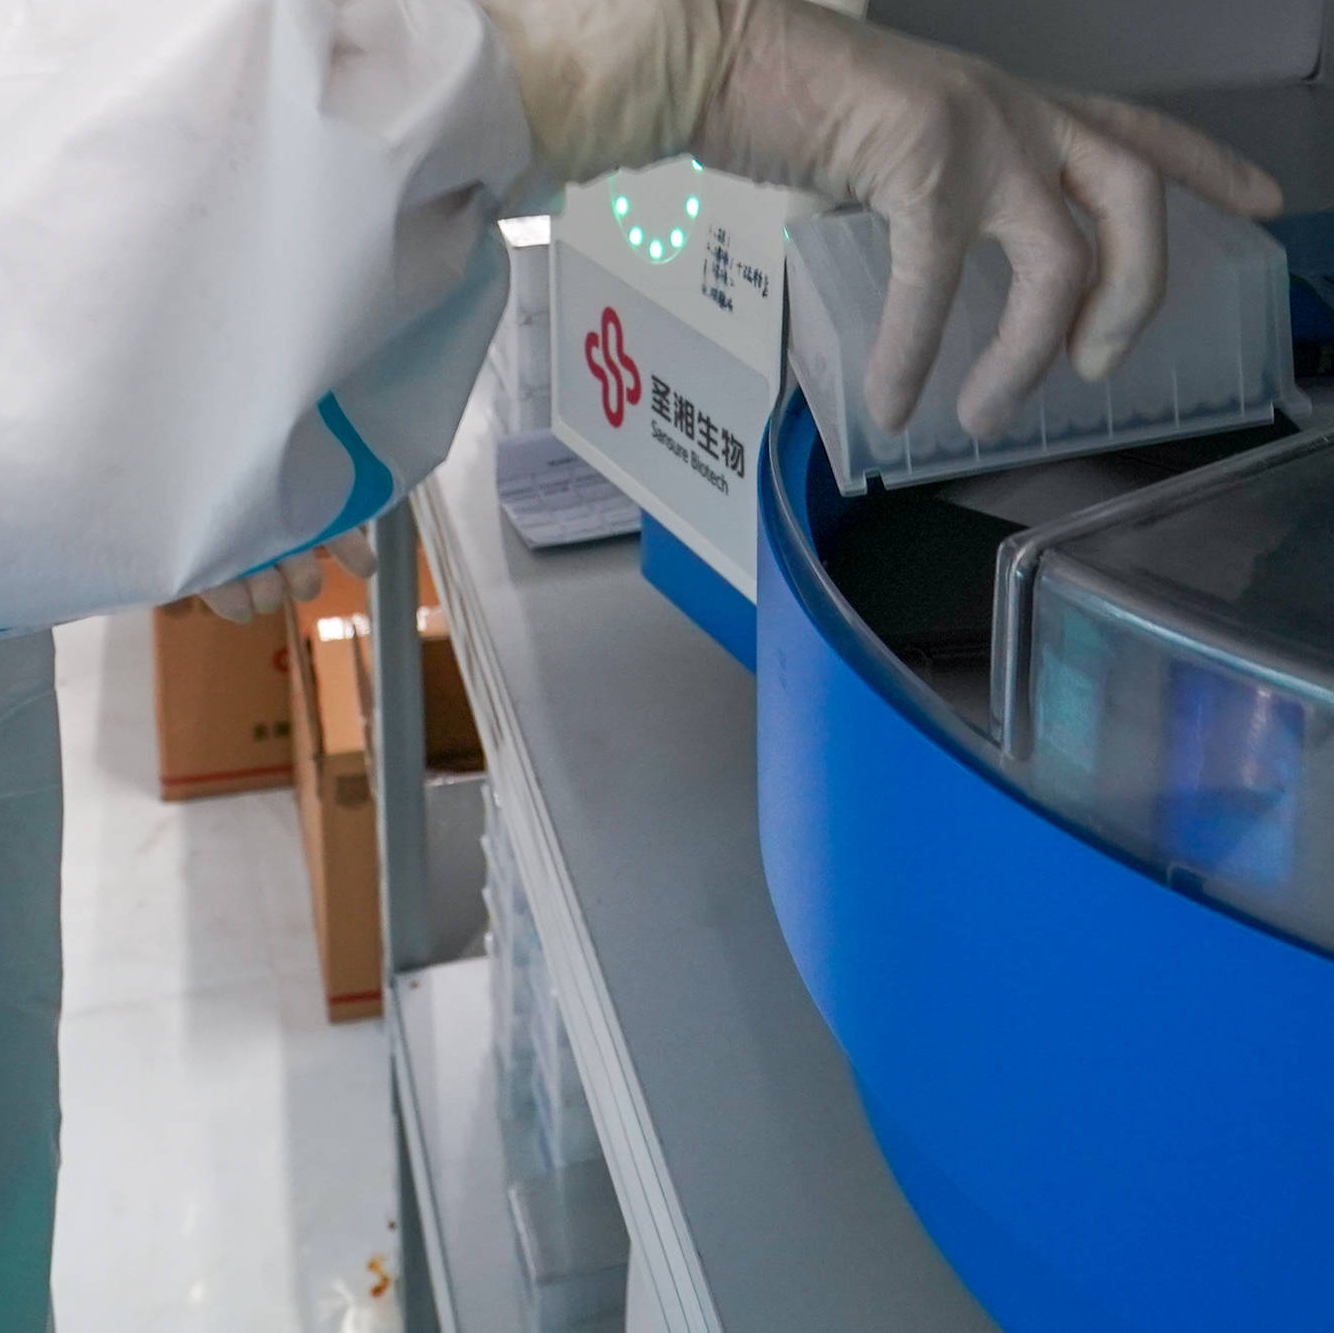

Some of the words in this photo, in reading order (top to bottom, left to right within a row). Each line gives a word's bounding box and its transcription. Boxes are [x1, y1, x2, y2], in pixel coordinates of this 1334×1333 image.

[650, 374, 745, 479] 圣湘生物
[651, 419, 690, 464] Sansure
[690, 450, 729, 496] Biotech
